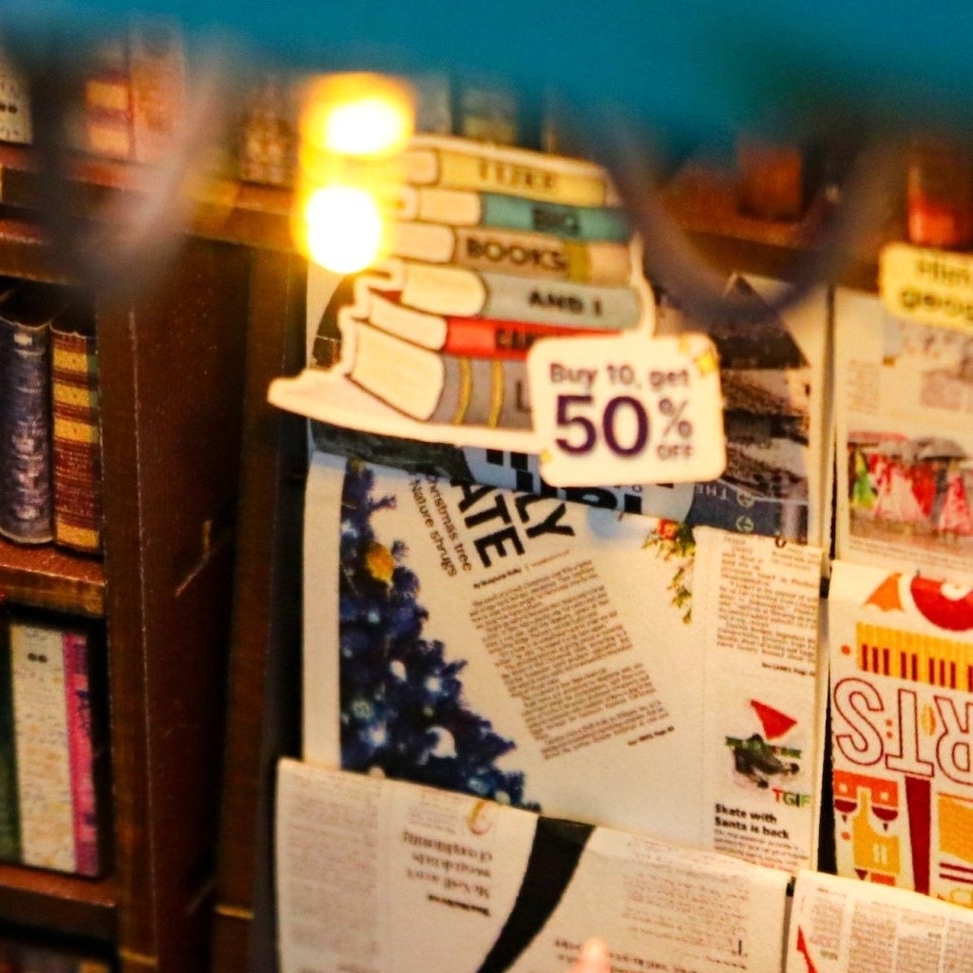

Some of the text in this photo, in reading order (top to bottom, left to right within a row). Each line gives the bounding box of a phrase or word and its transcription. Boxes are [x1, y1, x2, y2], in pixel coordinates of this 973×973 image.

[466, 238, 569, 273] BOOKS
[529, 289, 585, 315] AND
[549, 362, 598, 388] Buy
[648, 368, 691, 391] get
[408, 479, 458, 578] Nature shrugs
[454, 543, 473, 573] tree
[771, 787, 811, 809] TGIF
[714, 803, 778, 824] Skate with
[714, 816, 790, 840] Santa is back
